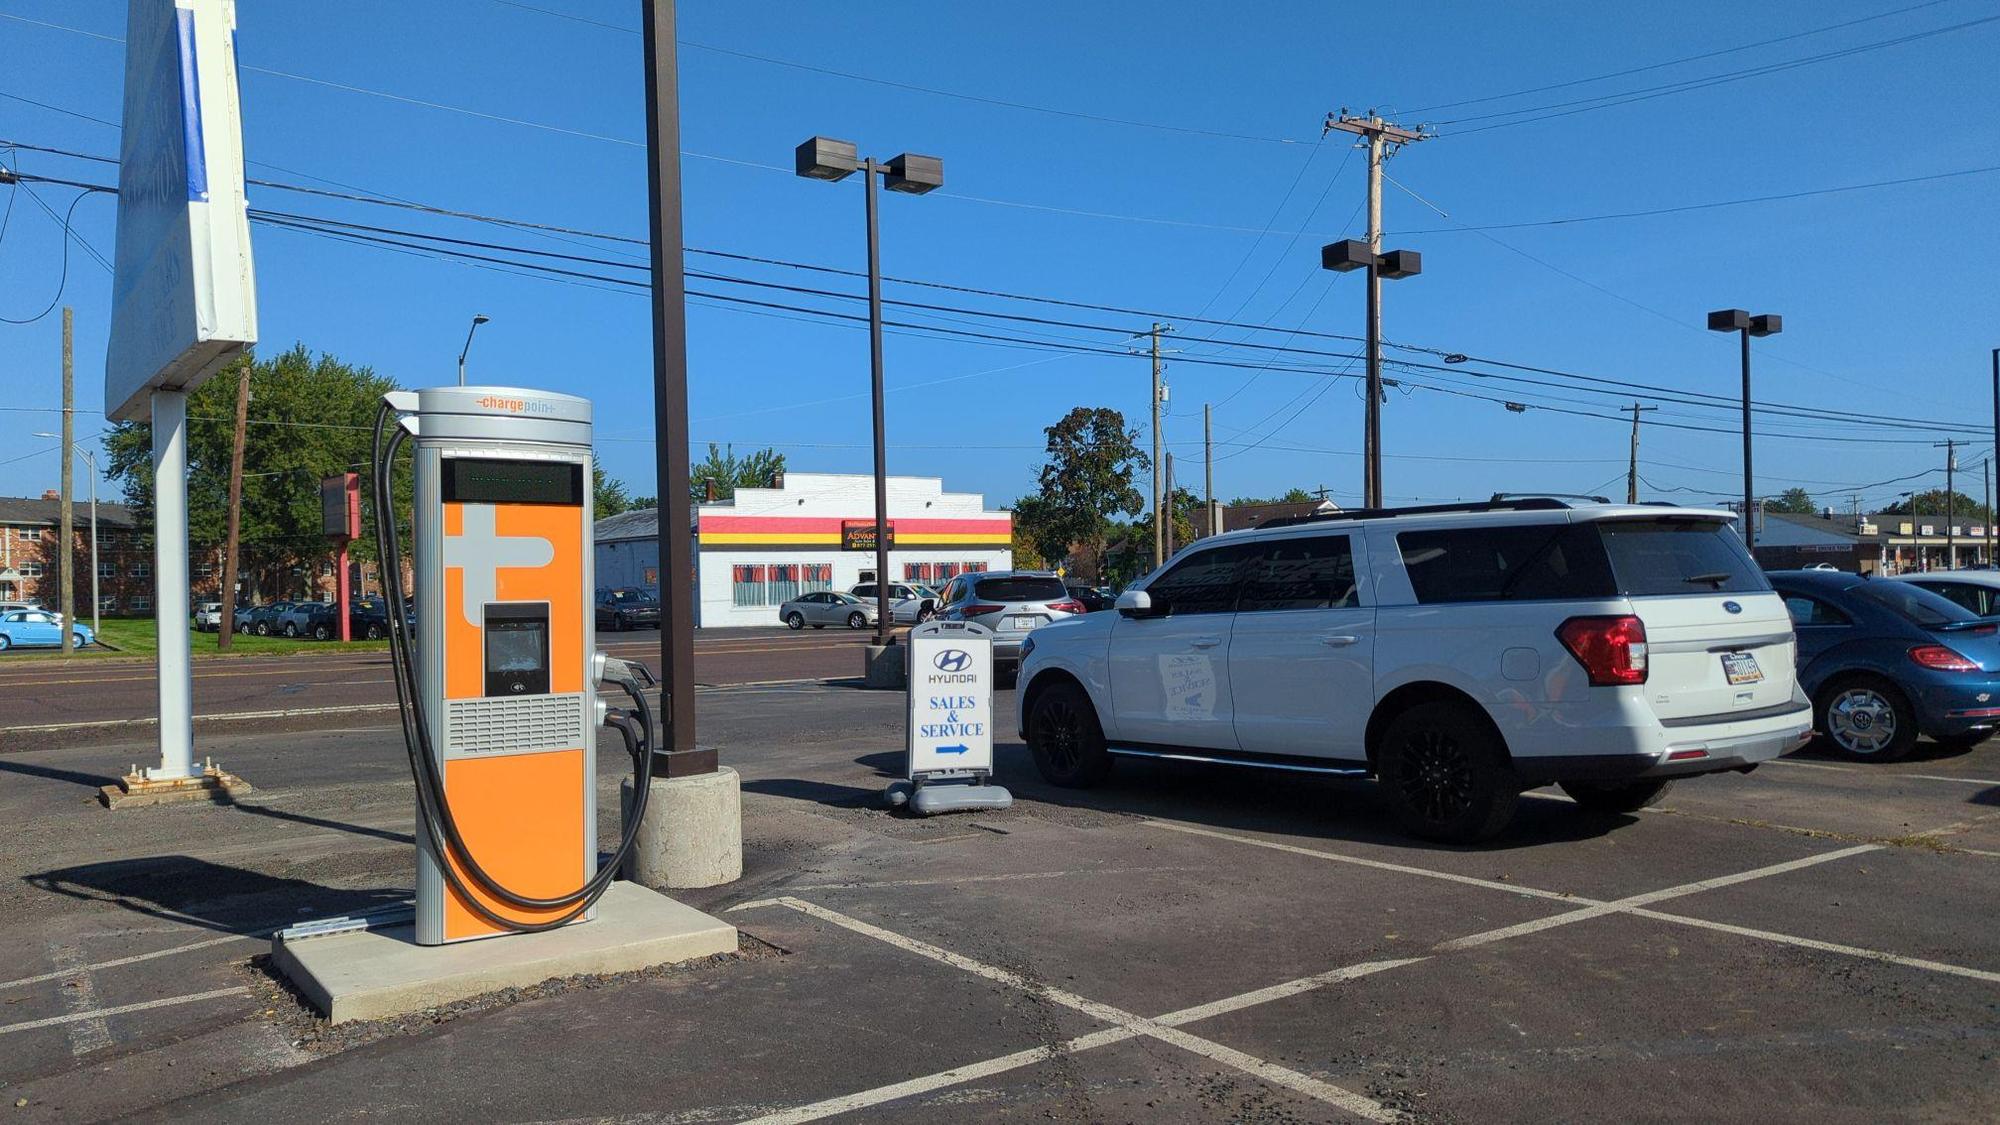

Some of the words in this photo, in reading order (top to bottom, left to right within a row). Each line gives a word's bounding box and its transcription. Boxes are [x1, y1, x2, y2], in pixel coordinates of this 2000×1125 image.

[847, 532, 893, 540] ADVANE
[928, 674, 977, 684] HYUNDAI
[930, 696, 976, 710] SALES
[947, 709, 959, 723] &
[921, 723, 983, 737] SERVICE
